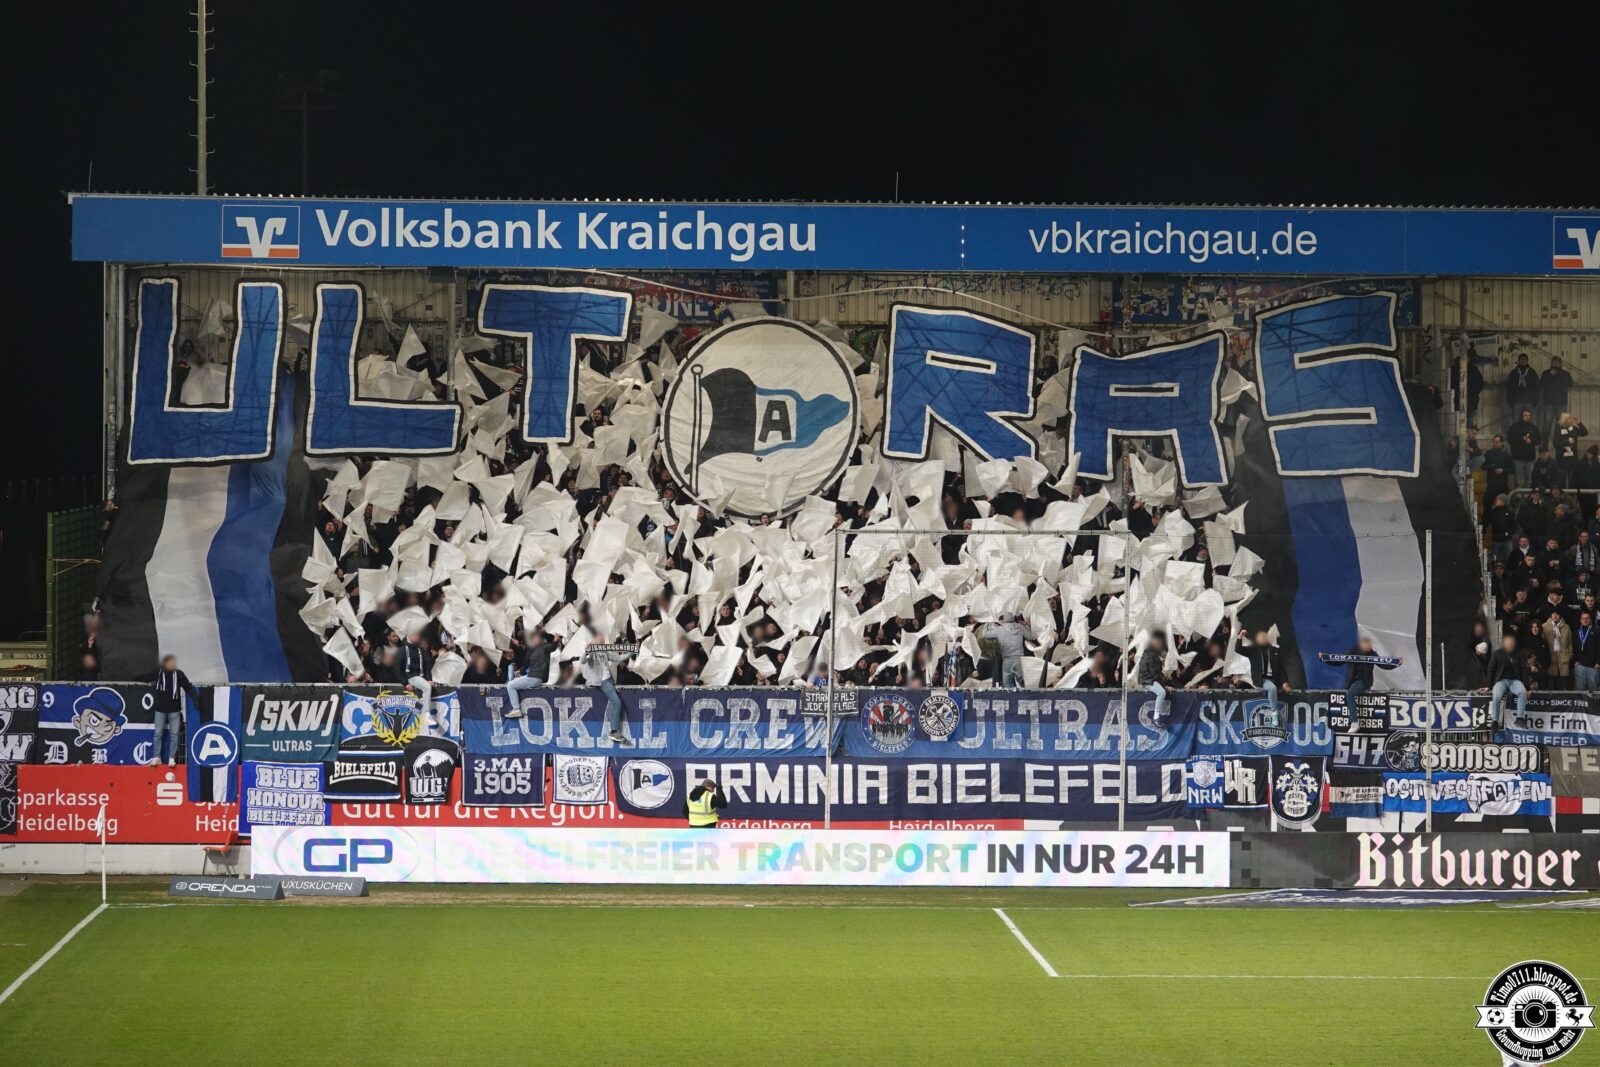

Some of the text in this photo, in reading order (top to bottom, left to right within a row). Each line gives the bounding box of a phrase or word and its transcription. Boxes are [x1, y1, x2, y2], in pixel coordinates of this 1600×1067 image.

[315, 207, 817, 262] Volksbank Kraichgau
[1028, 220, 1318, 263] vbkraichgau.de
[804, 701, 857, 711] JEDE AFLAGE
[805, 691, 855, 702] STÄRR ALS
[866, 694, 913, 711] LOKAL CREW
[924, 696, 956, 707] SEKTION
[1330, 694, 1345, 704] DIE
[486, 696, 668, 750] LOKAL
[957, 699, 1172, 751] ULTRAS
[1197, 700, 1332, 746] SK 05
[1331, 717, 1384, 729] DER IEGER
[1389, 700, 1472, 729] BOYS
[1551, 714, 1587, 731] Firm
[272, 740, 314, 752] ULTRAS
[872, 740, 909, 753] BIELEFELD
[1333, 735, 1386, 766] 647
[474, 757, 532, 772] 3.MAI
[1421, 743, 1538, 773] SAMSON
[256, 766, 319, 791] BLUE
[334, 761, 397, 778] BIELEFELD
[473, 772, 531, 795] 1905
[686, 763, 1188, 805] ARMINIA BIELEFELD
[1385, 777, 1547, 803] OSTWESTFALEN
[248, 789, 325, 811] HONOUR
[1187, 787, 1223, 804] NRW
[247, 810, 325, 826] BIELEFELD
[303, 837, 394, 873] GP
[731, 841, 977, 874] TRANSPORT
[986, 843, 1024, 874] IN
[1034, 843, 1116, 875] NUR
[1124, 844, 1205, 875] 24H
[1353, 832, 1582, 889] Bitburger
[188, 881, 257, 895] ORENDA
[281, 879, 353, 892] UXUSKÜCHEN
